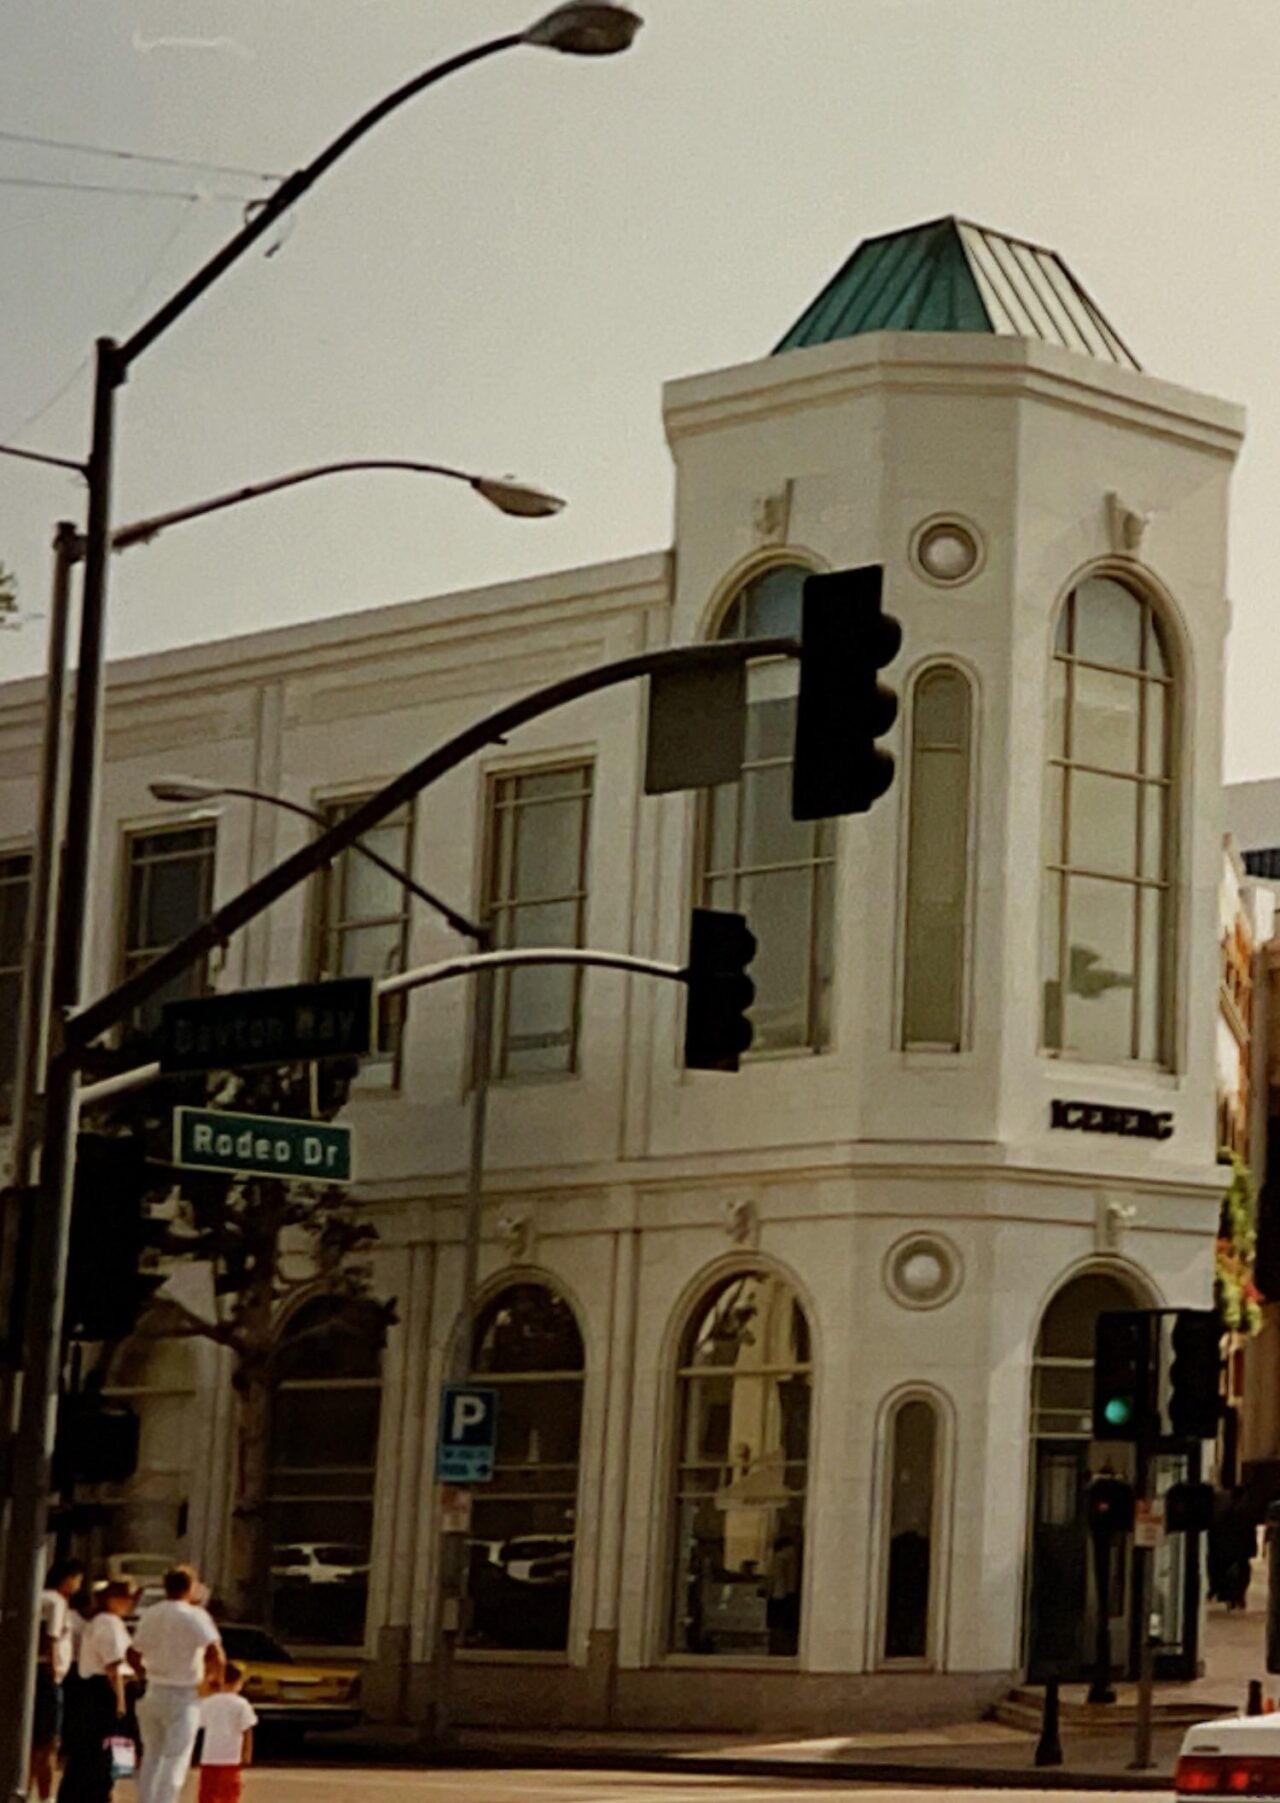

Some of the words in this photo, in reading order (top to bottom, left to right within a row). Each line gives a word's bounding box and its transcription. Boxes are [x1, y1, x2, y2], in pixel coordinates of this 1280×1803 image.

[176, 1016, 283, 1053] Dayton
[294, 1006, 354, 1044] Way
[193, 1124, 290, 1161] Rodeo
[304, 1137, 338, 1166] Dr
[452, 1396, 486, 1440] P
